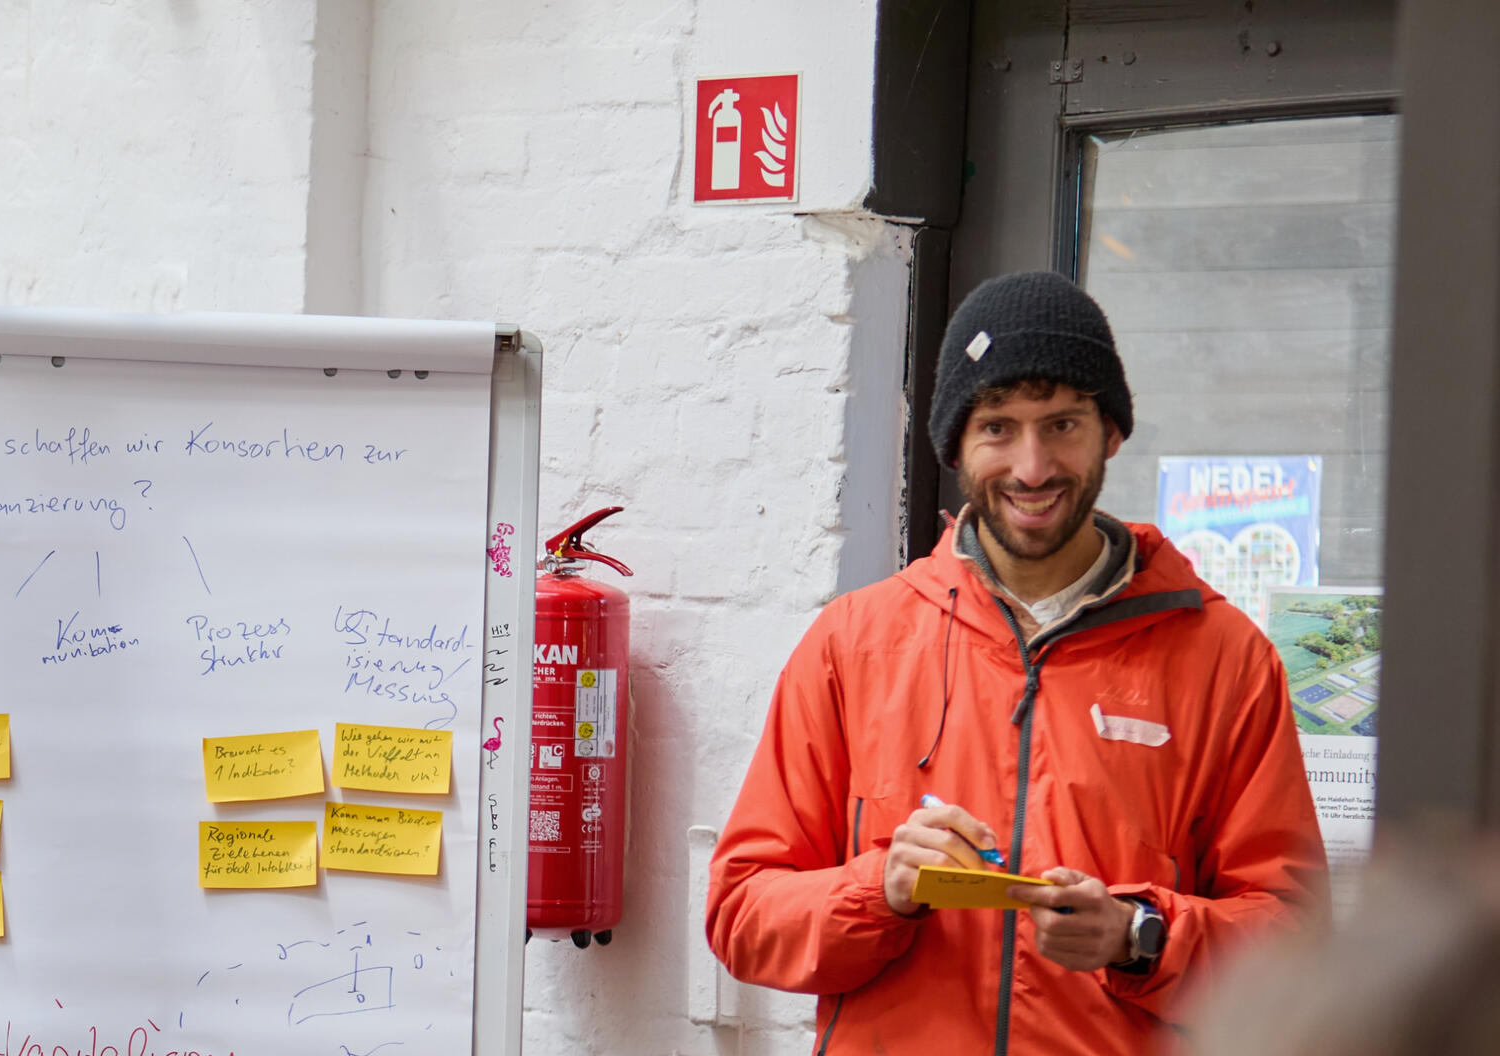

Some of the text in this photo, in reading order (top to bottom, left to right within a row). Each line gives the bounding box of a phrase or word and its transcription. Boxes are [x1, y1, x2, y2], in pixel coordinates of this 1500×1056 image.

[3, 427, 111, 465] schaffen
[125, 436, 164, 455] wir
[185, 421, 345, 461] Konsortien
[363, 446, 409, 464] zur
[533, 644, 578, 665] KAN
[1323, 749, 1370, 762] Einladung
